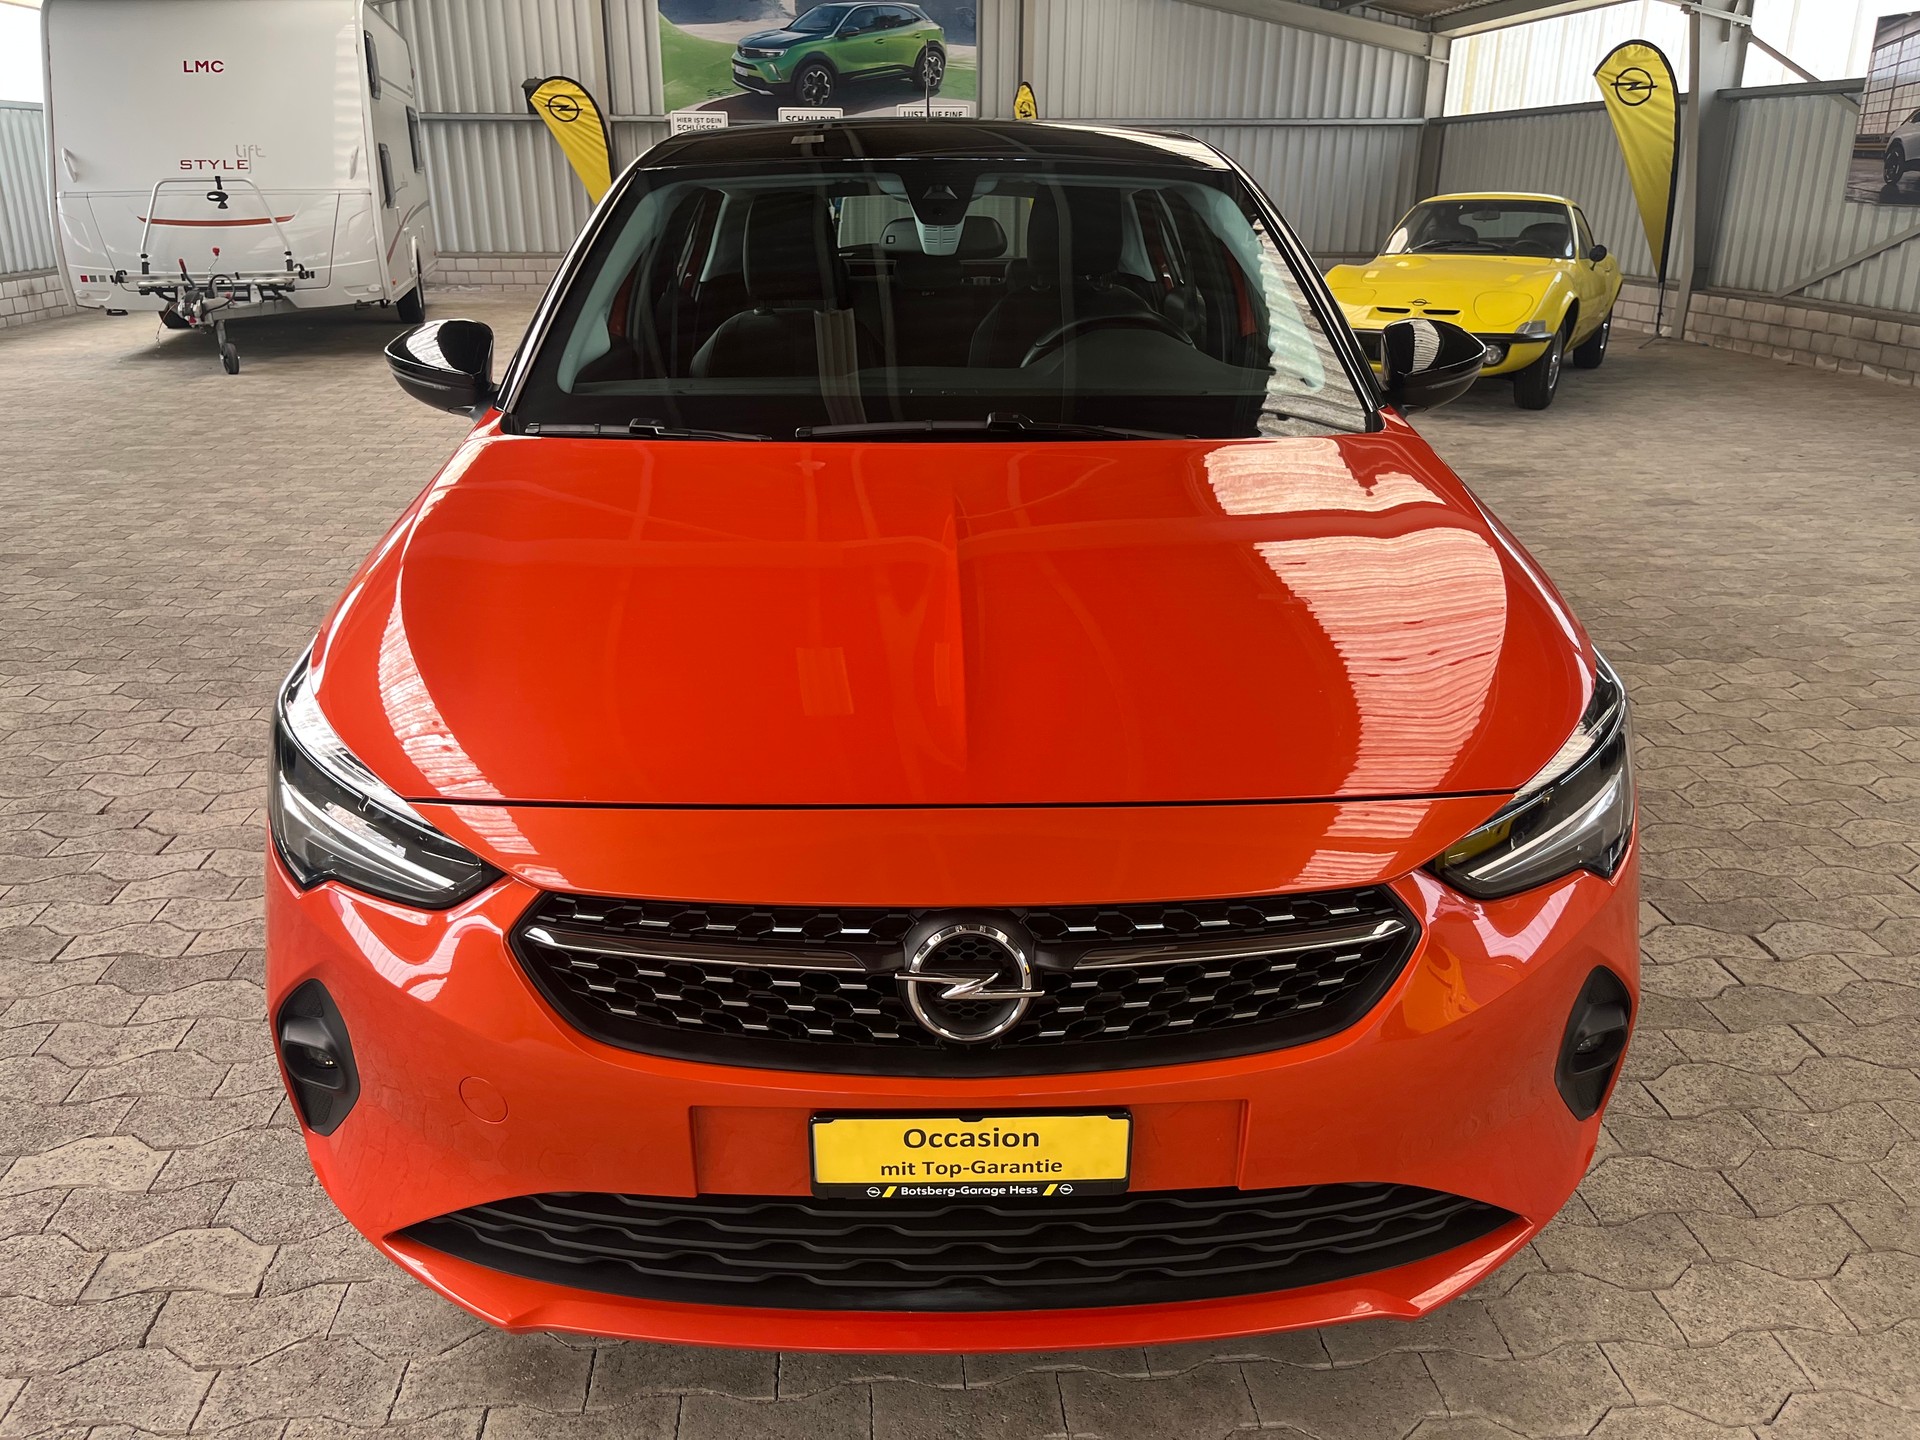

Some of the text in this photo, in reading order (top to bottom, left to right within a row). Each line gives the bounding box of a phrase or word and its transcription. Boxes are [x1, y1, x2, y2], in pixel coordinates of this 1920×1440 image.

[183, 60, 224, 73] LMC
[180, 159, 249, 170] STYLE
[235, 144, 266, 174] lift
[903, 1127, 1040, 1149] Occasion
[881, 1159, 1063, 1178] mit Top-Garantie
[901, 1185, 1038, 1197] Botsberg-Garage Hess
